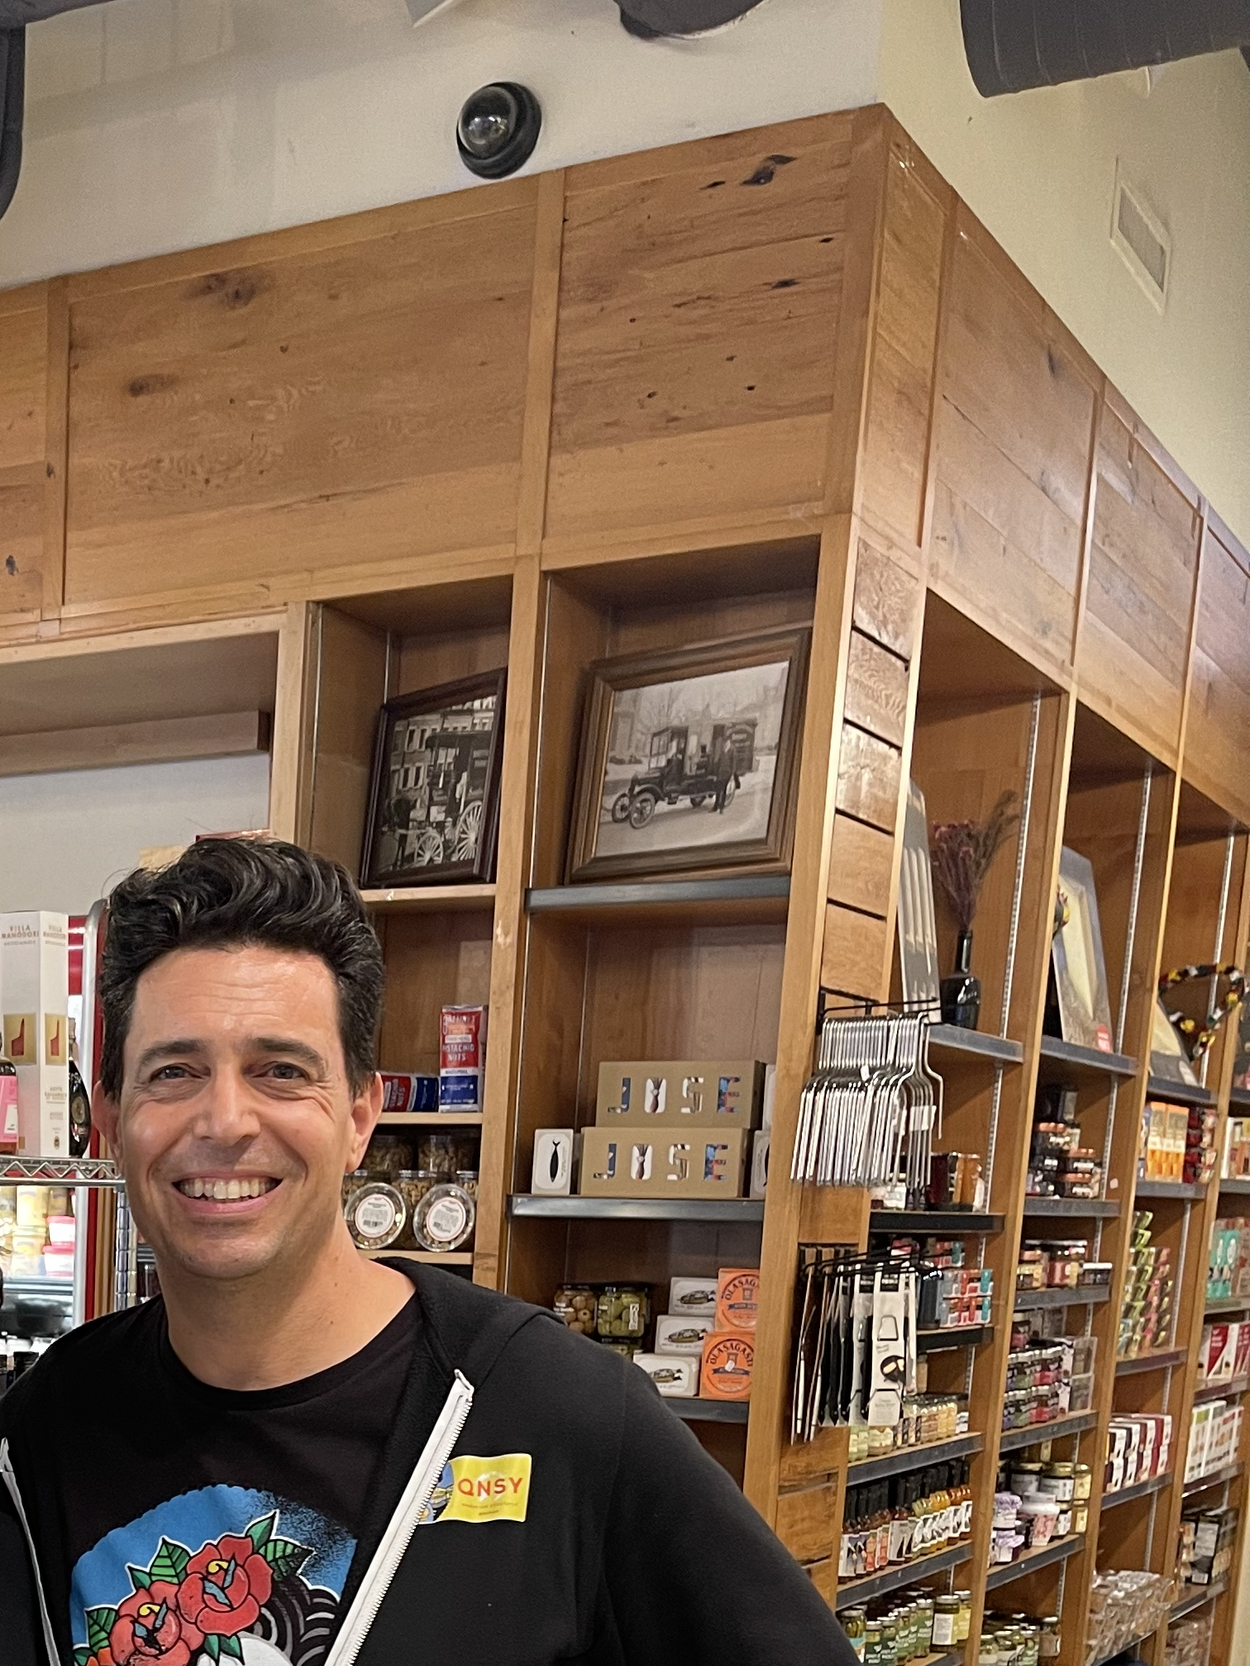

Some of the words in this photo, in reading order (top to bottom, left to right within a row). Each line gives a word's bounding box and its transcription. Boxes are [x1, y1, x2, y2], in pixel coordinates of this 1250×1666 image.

[607, 1076, 741, 1114] JOSE
[593, 1143, 728, 1181] JOSE
[457, 1477, 523, 1497] QNSY
